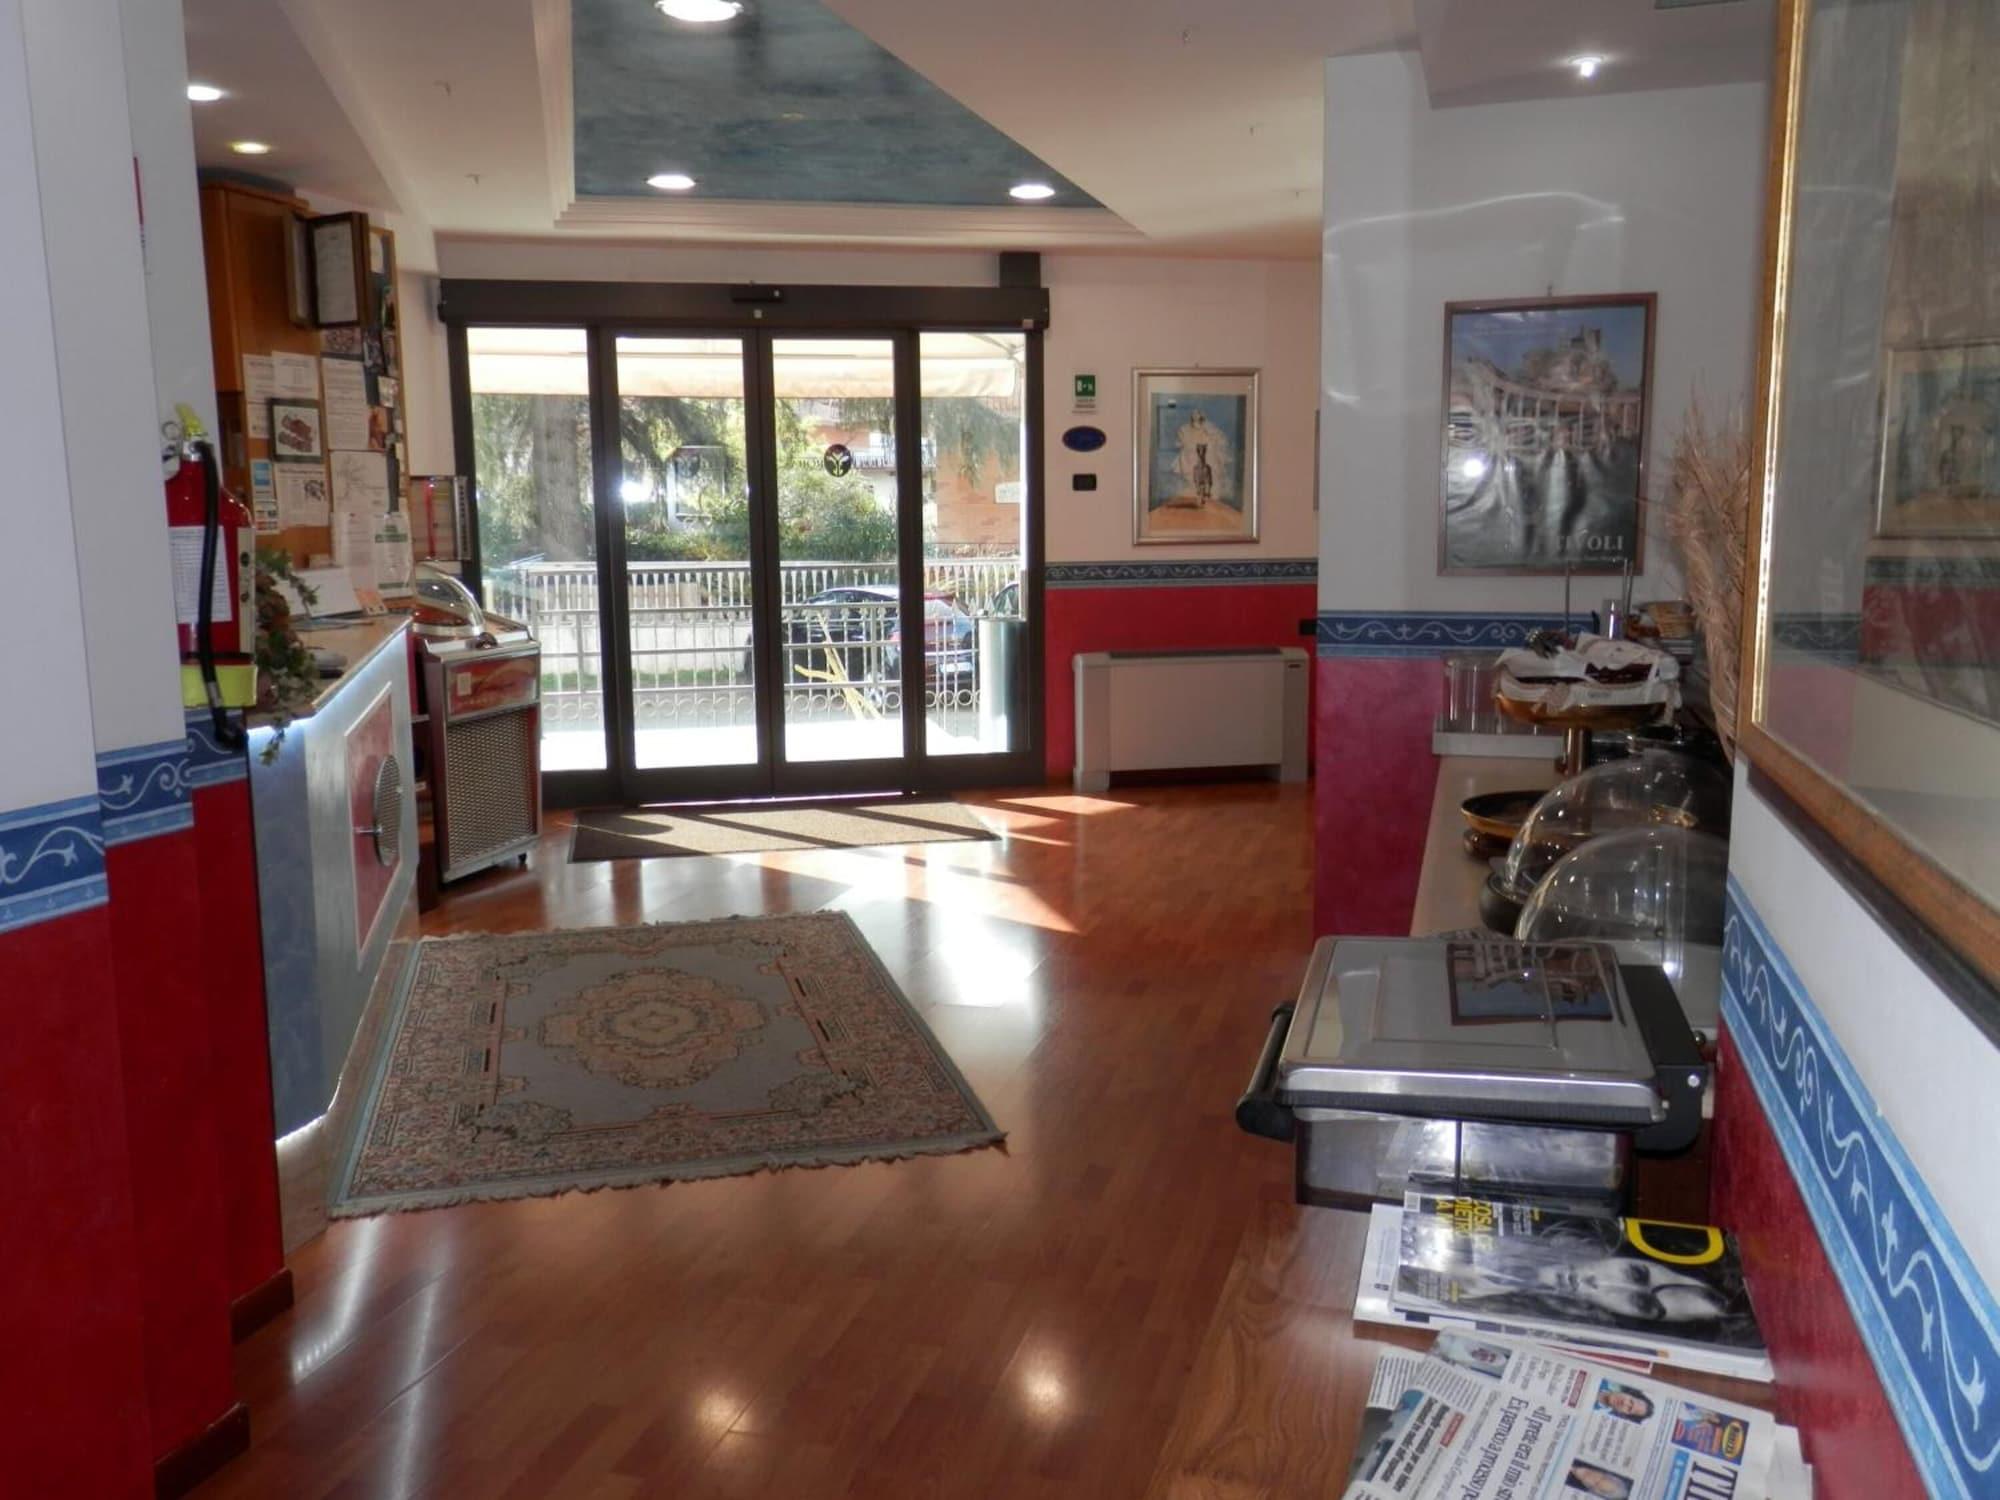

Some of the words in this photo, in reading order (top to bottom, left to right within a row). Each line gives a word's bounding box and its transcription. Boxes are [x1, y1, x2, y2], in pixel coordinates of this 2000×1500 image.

[1508, 1396, 1530, 1413] Ex
[1491, 1408, 1519, 1443] parroco
[1521, 1416, 1543, 1445] prete
[1488, 1439, 1502, 1452] a
[1515, 1442, 1532, 1460] era
[1469, 1445, 1499, 1490] processo
[1510, 1458, 1530, 1471] il
[1502, 1467, 1523, 1489] mio
